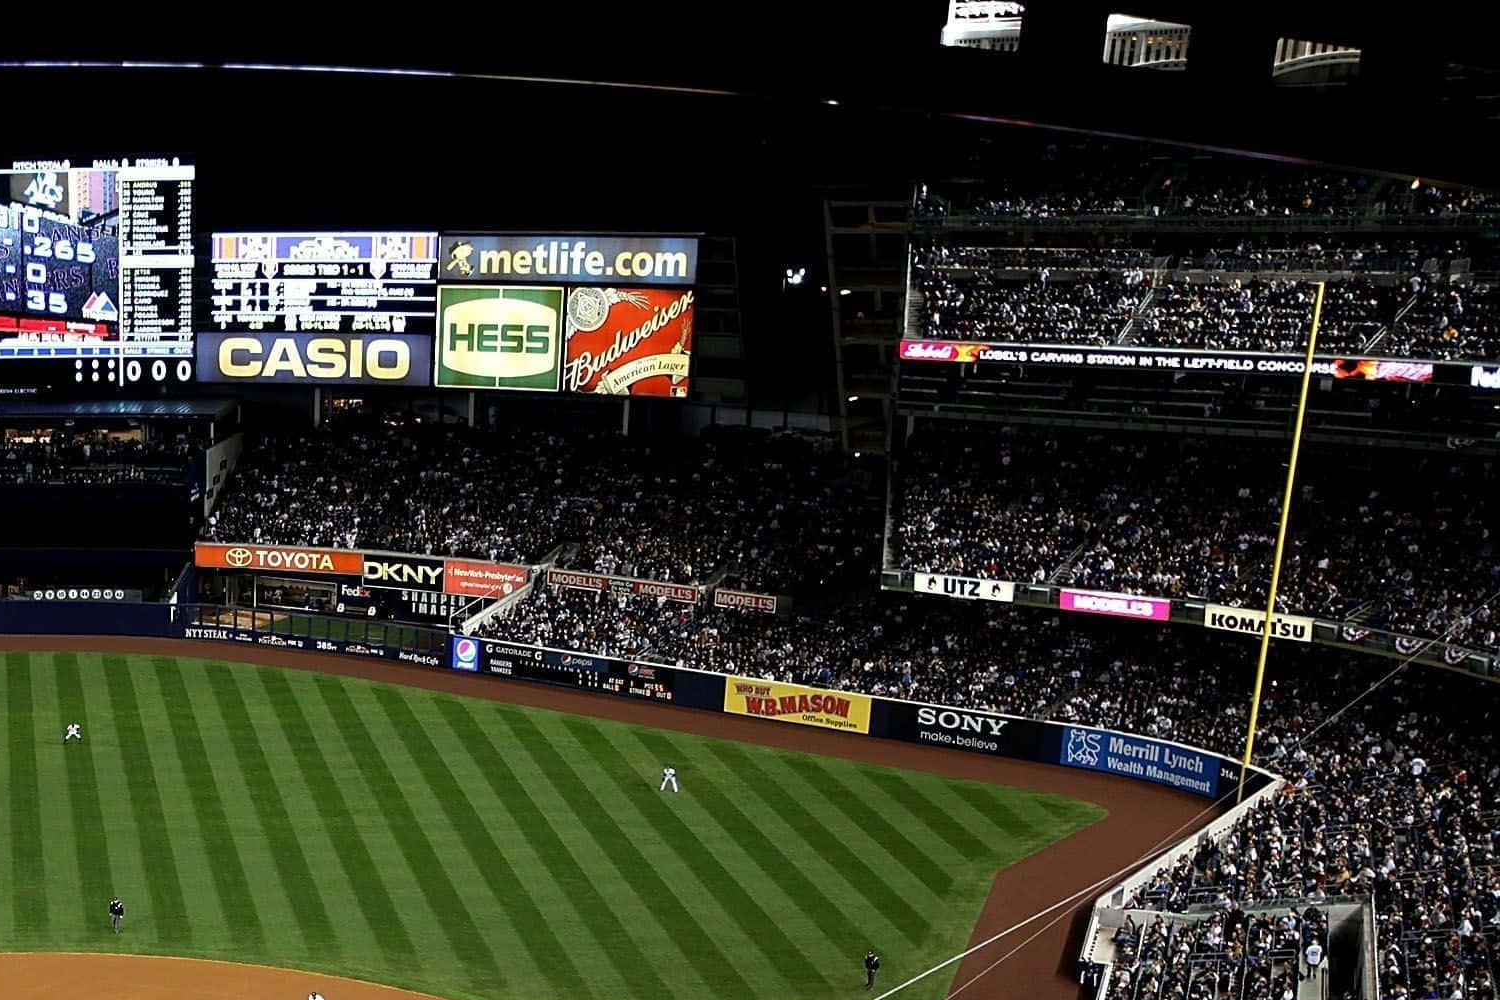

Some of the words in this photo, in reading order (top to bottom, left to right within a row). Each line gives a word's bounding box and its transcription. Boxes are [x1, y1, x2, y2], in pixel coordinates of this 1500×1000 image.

[25, 237, 96, 263] .265
[479, 241, 687, 277] metlife.com
[26, 262, 47, 284] 0
[26, 290, 67, 313] 35
[449, 323, 549, 354] HESS
[564, 290, 695, 392] Budweiser
[218, 337, 411, 380] CASIO
[1031, 351, 1084, 364] CARVING
[1086, 354, 1136, 366] STATION
[1139, 355, 1153, 367] IN
[1155, 356, 1181, 368] THE
[1184, 357, 1254, 371] LEFT-FIELD
[126, 360, 141, 382] 0
[151, 360, 167, 382] 0
[176, 360, 192, 382] 0
[612, 362, 656, 389] American
[657, 359, 686, 372] Lager
[256, 549, 335, 571] TOYOTA
[363, 561, 444, 585] DKNY
[552, 573, 603, 588] MODELL'S
[341, 584, 371, 598] FedEx
[638, 584, 692, 600] MODELL'S
[944, 578, 981, 596] UTZ
[401, 590, 466, 607] SHARPER
[717, 593, 774, 610] MODELL'S
[411, 602, 456, 617] IMAGE
[203, 629, 228, 640] STEAK
[398, 651, 412, 660] Hard
[413, 653, 426, 664] Rock
[426, 655, 439, 666] Cafe
[495, 646, 532, 658] GATORADE
[490, 659, 513, 668] RANGERS
[490, 666, 512, 675] YANKEES
[736, 683, 753, 694] WHO
[754, 685, 772, 696] BUT
[802, 714, 824, 724] Office
[825, 718, 858, 729] Supplies
[917, 707, 1008, 736] SONY
[920, 729, 998, 751] make.believe
[1109, 736, 1160, 762] Merrill
[1164, 747, 1203, 774] Lynch
[1106, 757, 1144, 776] Wealth
[1146, 764, 1211, 793] Management
